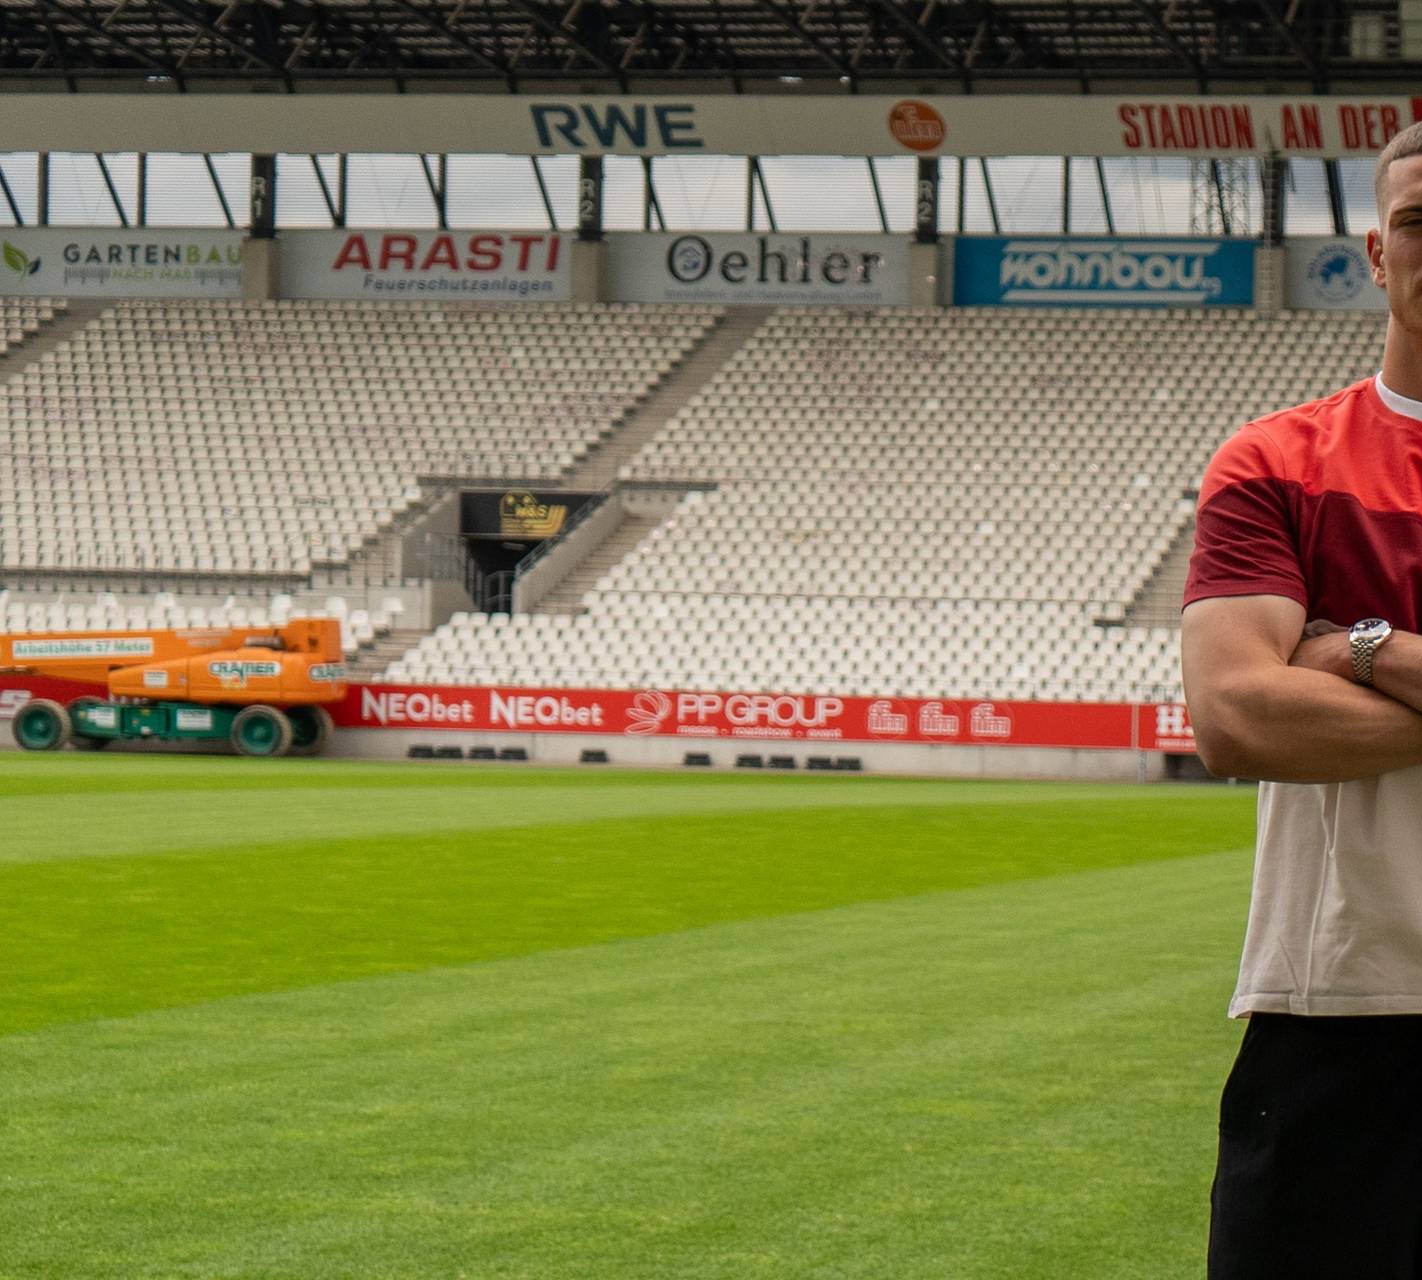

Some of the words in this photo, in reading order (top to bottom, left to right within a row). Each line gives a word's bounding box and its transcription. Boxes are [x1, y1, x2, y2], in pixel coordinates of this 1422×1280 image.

[530, 103, 704, 147] RWE
[1119, 103, 1256, 149] STADION
[1281, 103, 1324, 149] AN
[1339, 104, 1400, 149] DER
[63, 243, 241, 264] GARTENBAU
[332, 234, 561, 273] ARASTI
[667, 234, 881, 284] Oehler
[363, 274, 553, 295] Feuerschutzanlagen
[113, 639, 151, 652] Meter
[677, 693, 722, 723] PP
[725, 694, 843, 727] GROUP
